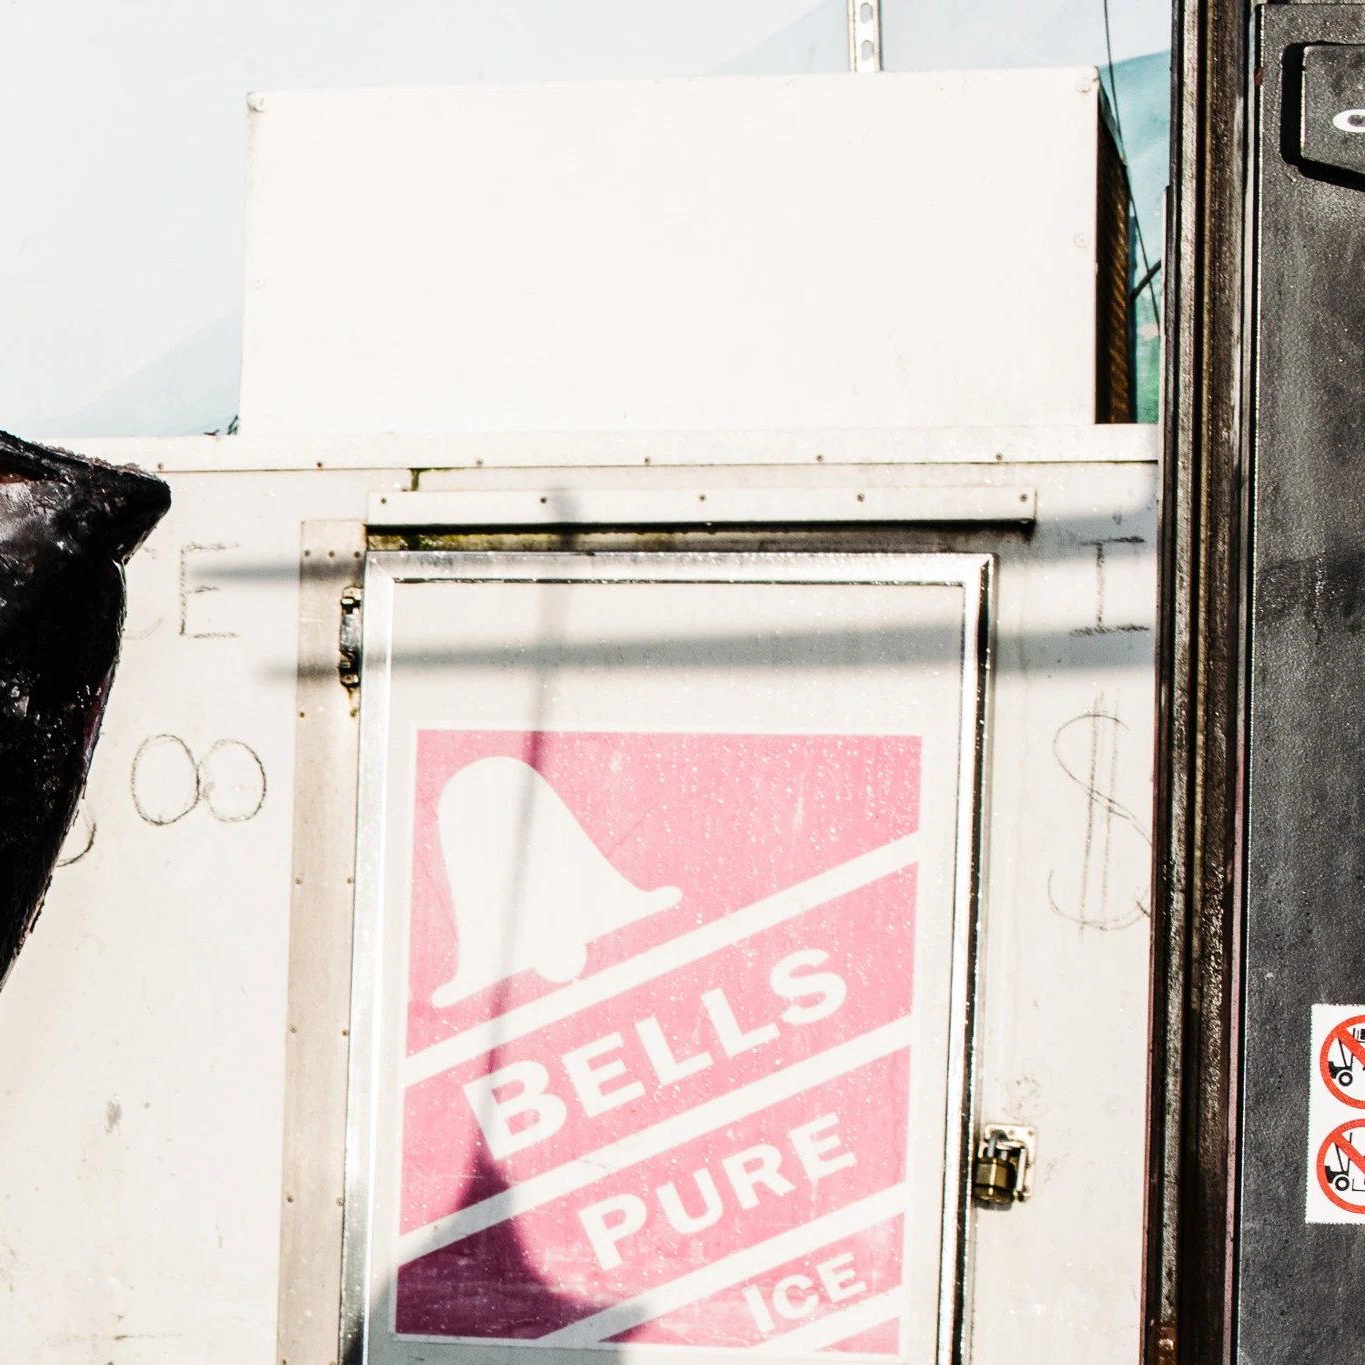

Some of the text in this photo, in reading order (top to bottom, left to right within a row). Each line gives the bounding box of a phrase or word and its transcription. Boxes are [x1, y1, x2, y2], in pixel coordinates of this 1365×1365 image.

[462, 948, 849, 1161] BELLS
[578, 1111, 859, 1271] PURE
[741, 1252, 868, 1333] ICE
